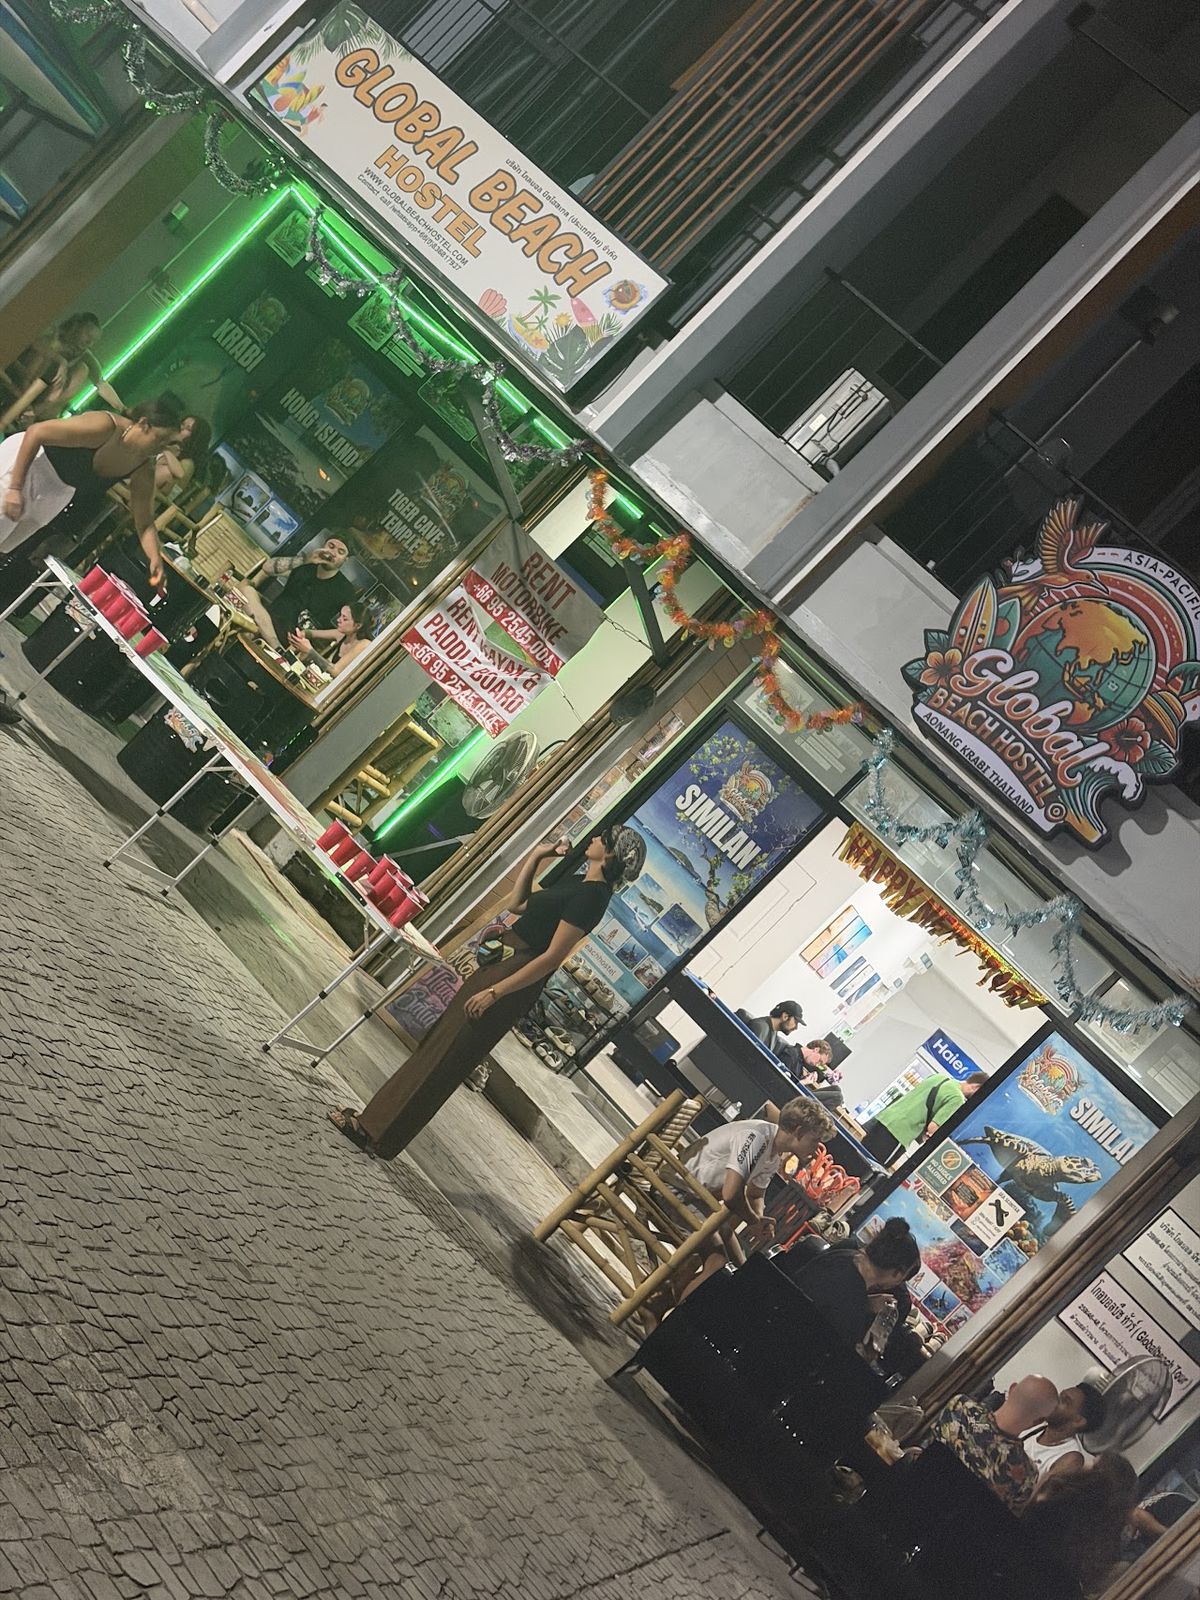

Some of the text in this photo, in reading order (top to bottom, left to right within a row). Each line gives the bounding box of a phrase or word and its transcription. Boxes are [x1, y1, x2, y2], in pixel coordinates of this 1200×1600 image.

[335, 47, 611, 298] GLOBAL BEACH
[356, 173, 380, 196] Contact
[374, 145, 486, 259] HOSTEL
[362, 166, 469, 266] WWW.GLOBALBEACHHOSTEL.COM
[211, 318, 267, 373] KRABI
[278, 387, 361, 467] HONG ISLAND
[379, 509, 423, 554] TEMPLE
[387, 487, 445, 547] TIGER CAVE
[445, 596, 485, 643] RENT
[488, 561, 568, 646] MOTORBIKE
[519, 550, 577, 611] RENT
[411, 642, 431, 665] +66
[429, 660, 449, 681] 95
[422, 611, 525, 715] PADDLE BOARD
[469, 578, 557, 668] +66 95 2545 004
[929, 688, 1057, 809] BEACH HOSTEL
[949, 649, 1110, 788] Global
[922, 711, 1036, 816] AONANG KRABI THAILAND
[675, 784, 762, 870] SIMILAN
[931, 1037, 971, 1075] Haier
[926, 1163, 947, 1185] ALLOWED
[929, 1158, 939, 1167] NO
